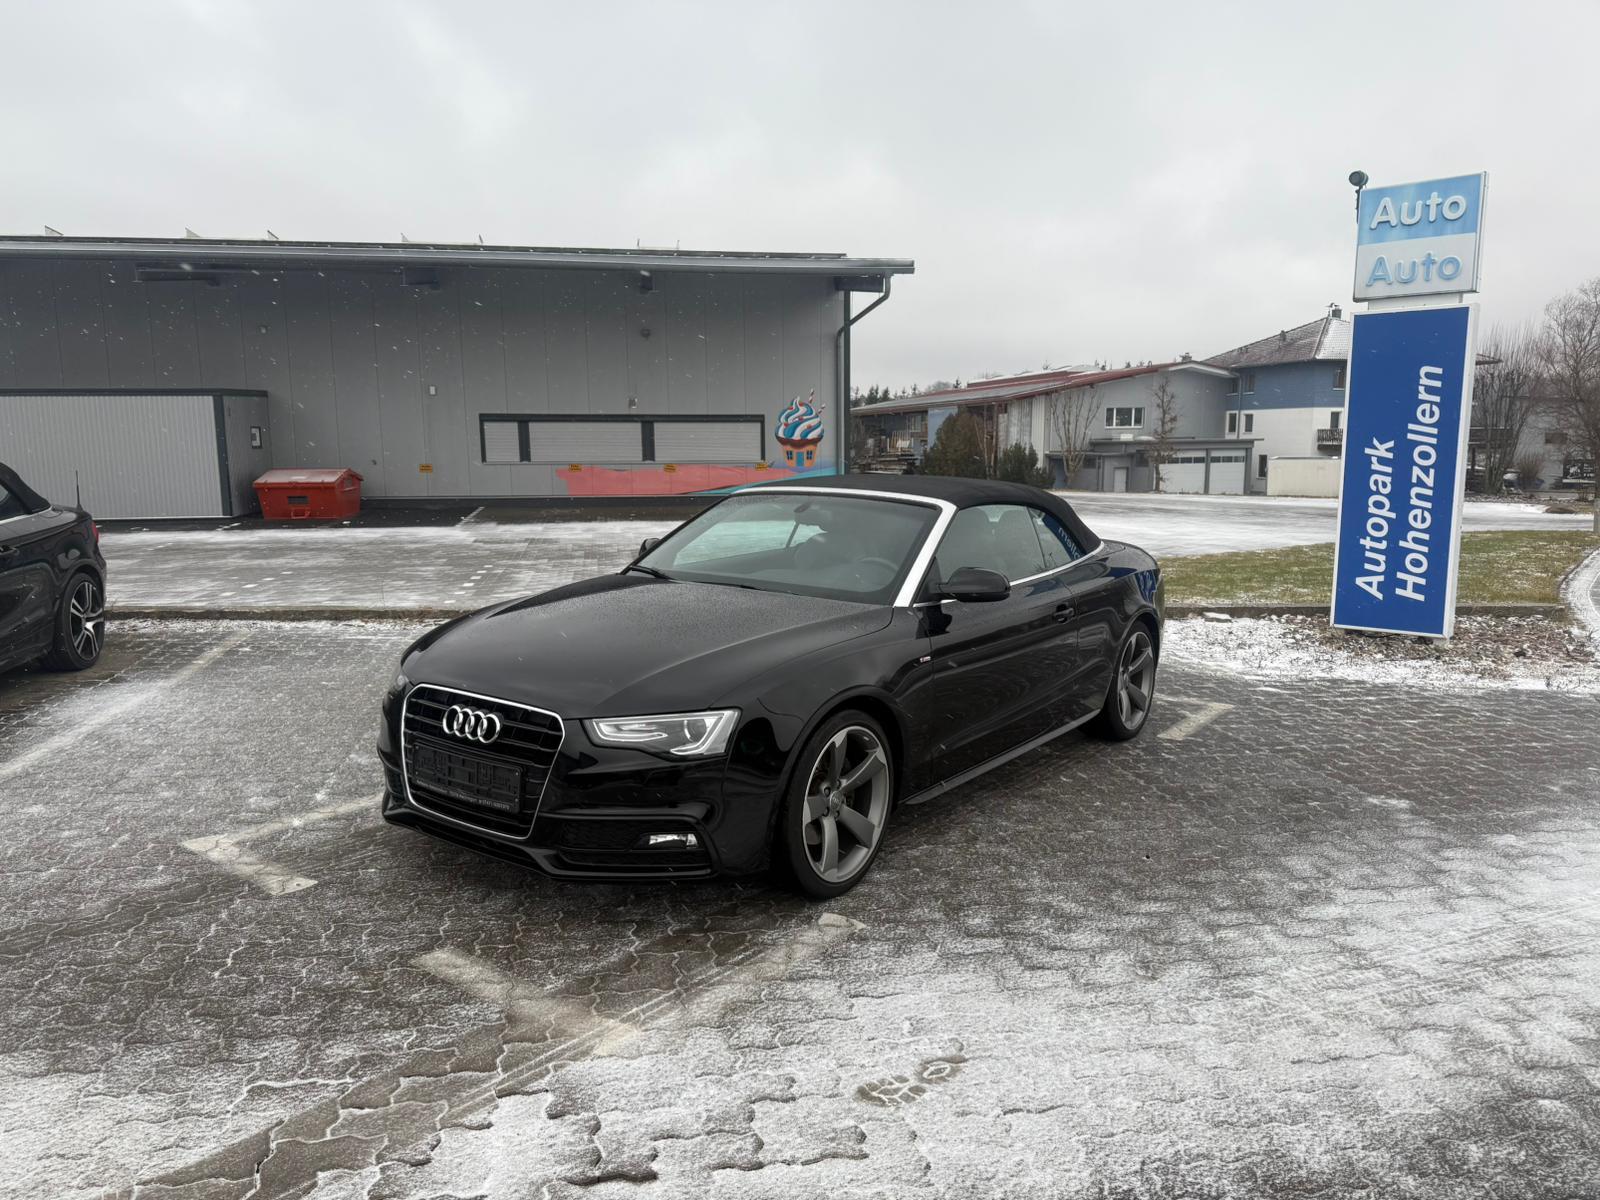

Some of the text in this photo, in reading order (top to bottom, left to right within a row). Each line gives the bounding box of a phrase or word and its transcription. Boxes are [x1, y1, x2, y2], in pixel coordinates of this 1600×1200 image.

[1369, 191, 1467, 230] Auto
[1365, 251, 1463, 287] Auto
[1355, 437, 1396, 601] Autopark
[1395, 366, 1443, 602] Hohenzollern
